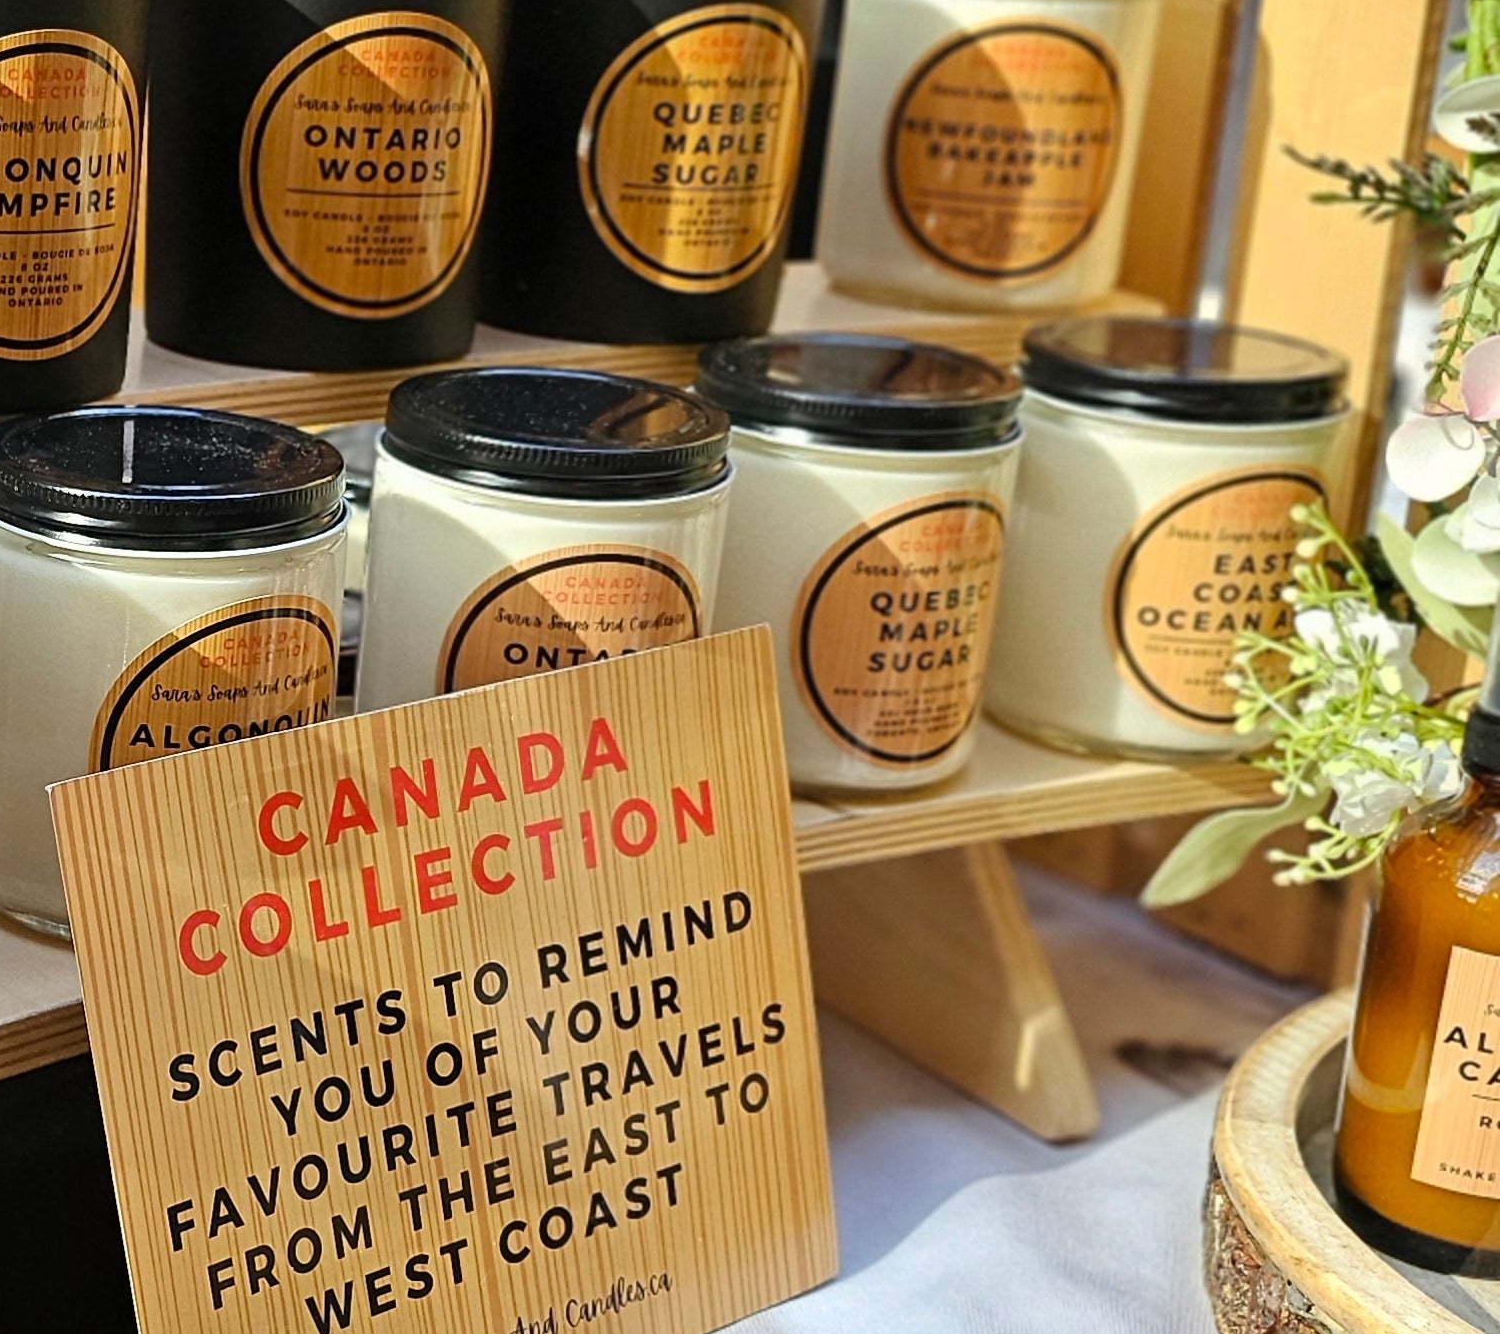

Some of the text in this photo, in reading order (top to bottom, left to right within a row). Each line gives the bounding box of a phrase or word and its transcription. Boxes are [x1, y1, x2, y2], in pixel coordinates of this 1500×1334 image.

[39, 117, 67, 133] And
[653, 101, 782, 127] QUEBEC
[304, 124, 461, 151] ONTARIO
[661, 133, 766, 155] MAPLE
[317, 157, 447, 183] WOODS
[652, 162, 758, 185] SUGAR
[870, 581, 990, 616] QUEBEC
[879, 613, 978, 643] MAPLE
[867, 644, 970, 673] SUGAR
[152, 677, 280, 703] Sara's Soaps And
[258, 717, 628, 856] CANADA
[179, 779, 716, 976] COLLECTION
[169, 890, 752, 1102] SCENTS TO REMIND
[271, 975, 681, 1137] YOU OF YOUR
[166, 1003, 786, 1253] FAVOURITE TRAVELS
[207, 1072, 770, 1311] FROM THE EAST TO
[499, 1163, 683, 1264] COAST
[566, 1271, 673, 1328] Candles.ca
